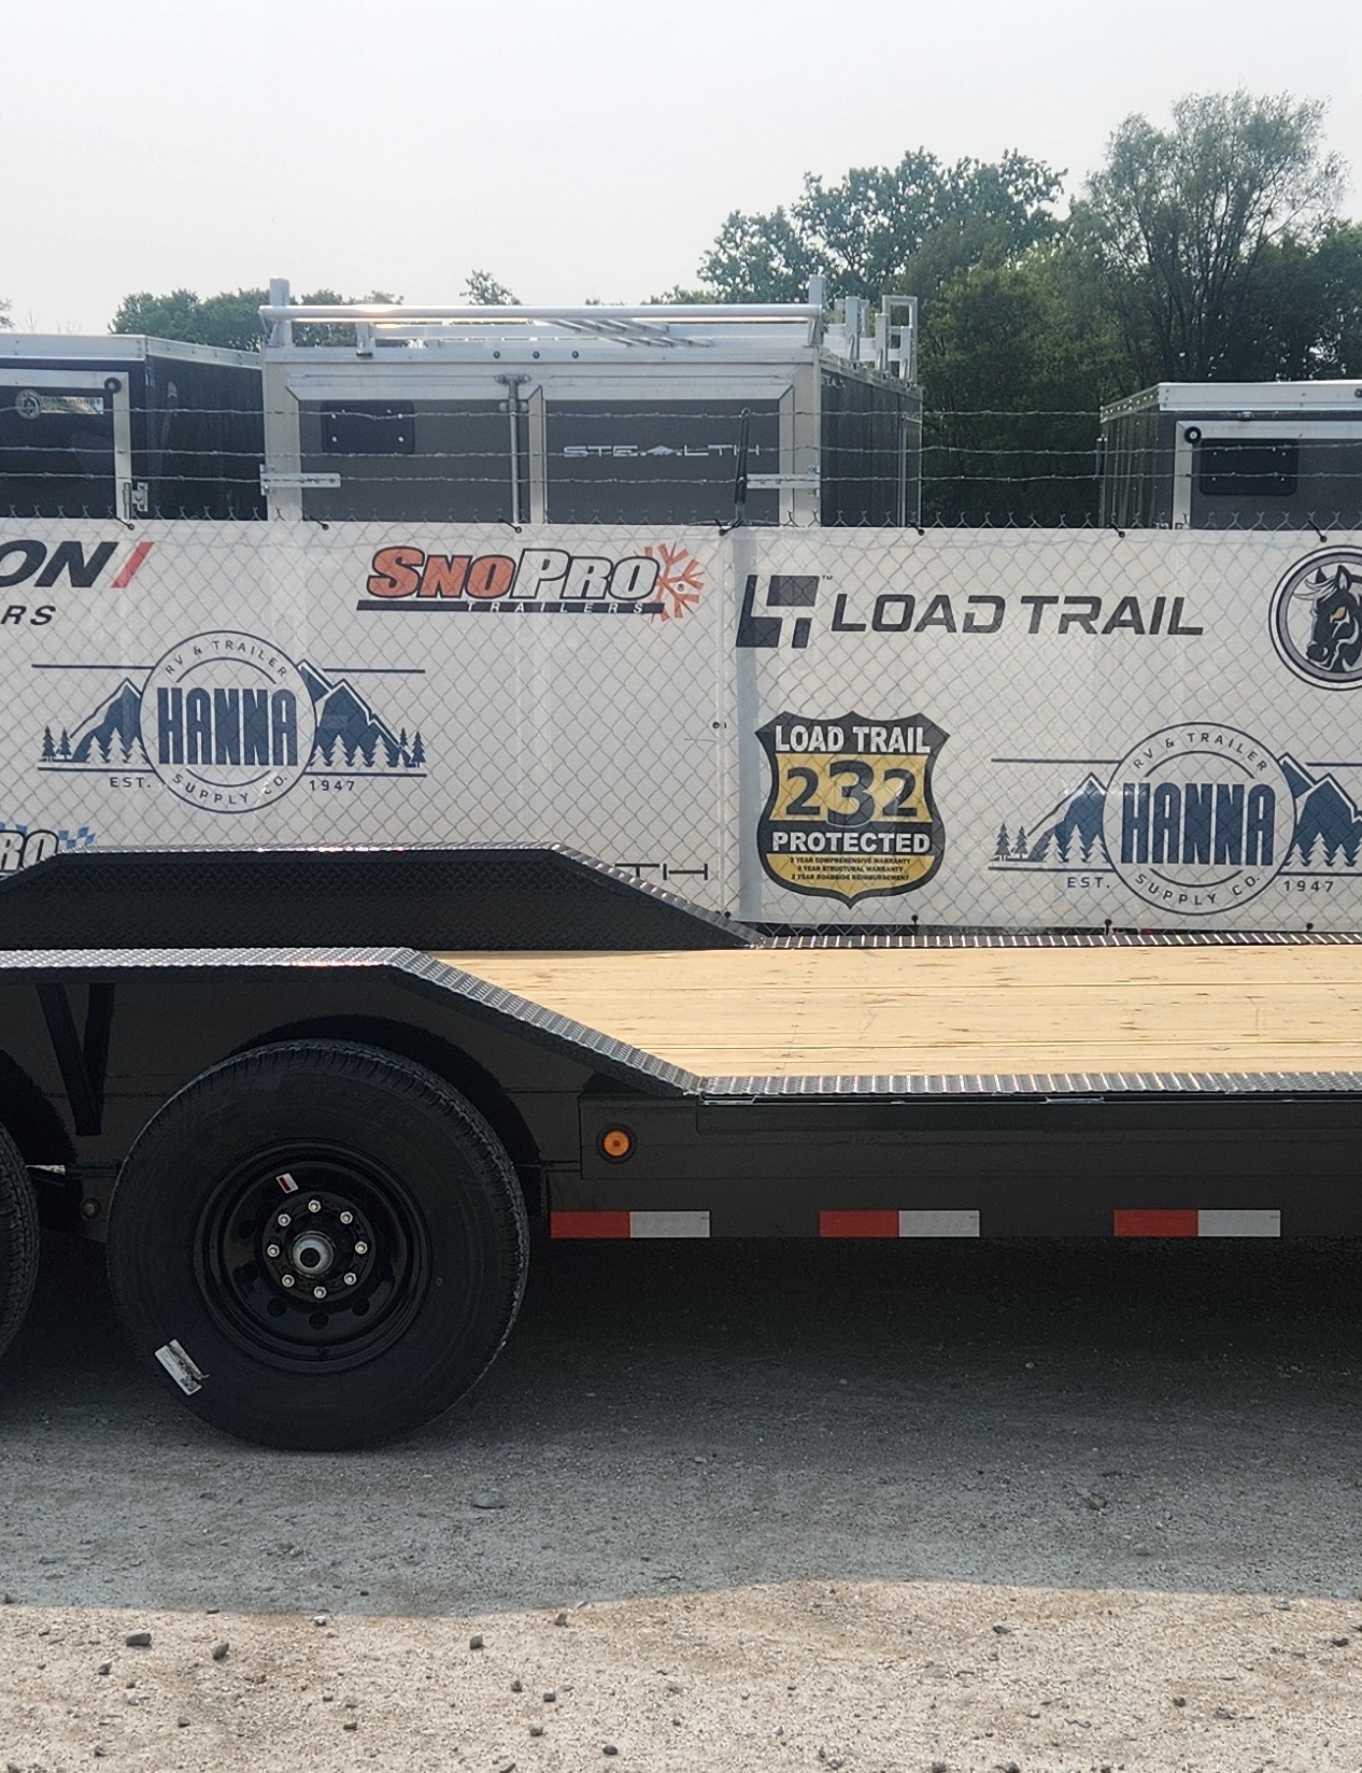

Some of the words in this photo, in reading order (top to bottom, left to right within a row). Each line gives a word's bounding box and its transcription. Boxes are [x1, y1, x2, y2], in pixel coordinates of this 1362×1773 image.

[467, 602, 644, 614] TRAILERS
[831, 592, 1007, 635] LOAD
[1020, 594, 1204, 636] TRAIL
[164, 654, 184, 676] RV
[192, 645, 203, 656] &
[212, 639, 288, 679] TRAILER
[157, 687, 299, 767] HANNA
[775, 724, 845, 752] LOAD
[852, 726, 931, 754] TRAIL
[1133, 748, 1155, 770] RV
[1164, 737, 1176, 748] &
[1186, 732, 1270, 772] TRAILER
[109, 776, 152, 789] EST.
[171, 773, 251, 806] SUPPLY
[309, 779, 356, 792] 1947
[785, 759, 918, 829] 232
[1121, 781, 1276, 866] HANNA
[771, 831, 931, 853] PROTECTED
[1067, 876, 1111, 889] EST.
[1135, 873, 1218, 907] SUPPLY
[1231, 873, 1261, 896] CO.
[1283, 879, 1335, 893] 1947
